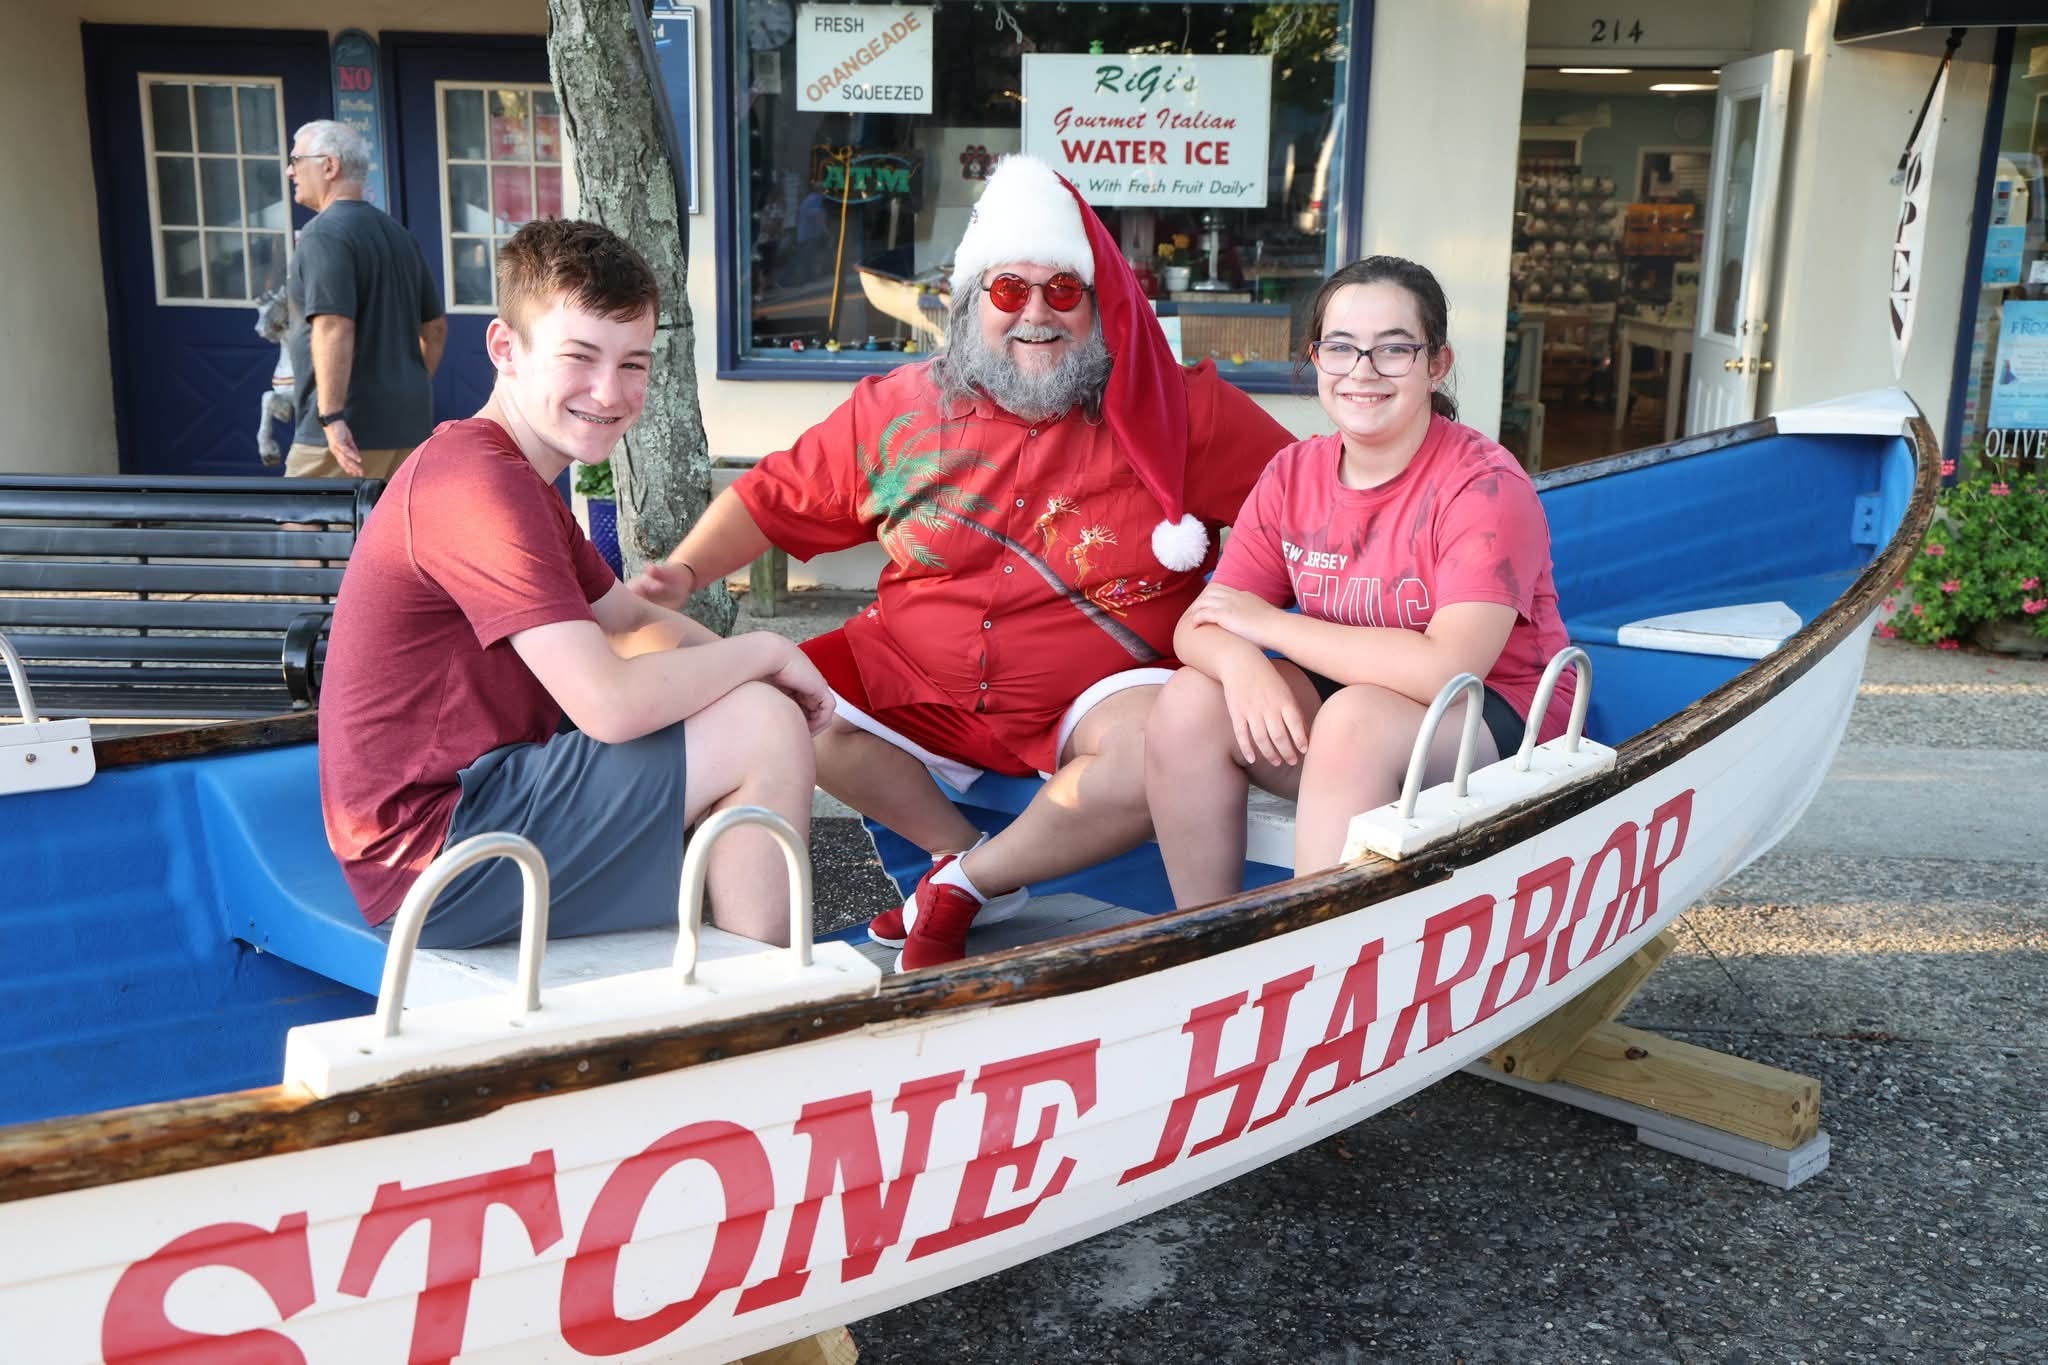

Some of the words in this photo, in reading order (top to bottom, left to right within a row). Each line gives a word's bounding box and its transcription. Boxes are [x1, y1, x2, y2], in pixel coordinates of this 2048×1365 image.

[814, 16, 864, 33] FRESH
[1591, 17, 1644, 43] 214
[806, 11, 921, 102] ORANGEADE
[336, 66, 372, 92] NO
[842, 84, 923, 101] SQUEEZED
[1053, 106, 1147, 135] Gourmet
[1156, 108, 1237, 129] Italian
[1061, 139, 1168, 165] WATER
[1185, 141, 1230, 165] ICE
[823, 165, 911, 193] ATM
[1089, 178, 1122, 193] With
[1128, 178, 1166, 194] Fresh
[1171, 180, 1204, 194] Fruit
[1890, 151, 1922, 341] OPEN
[1984, 428, 2048, 459] OLIVE
[1303, 551, 1348, 571] JERSEY
[102, 1038, 1101, 1365] STONE
[1117, 788, 1695, 1186] HARBOR
